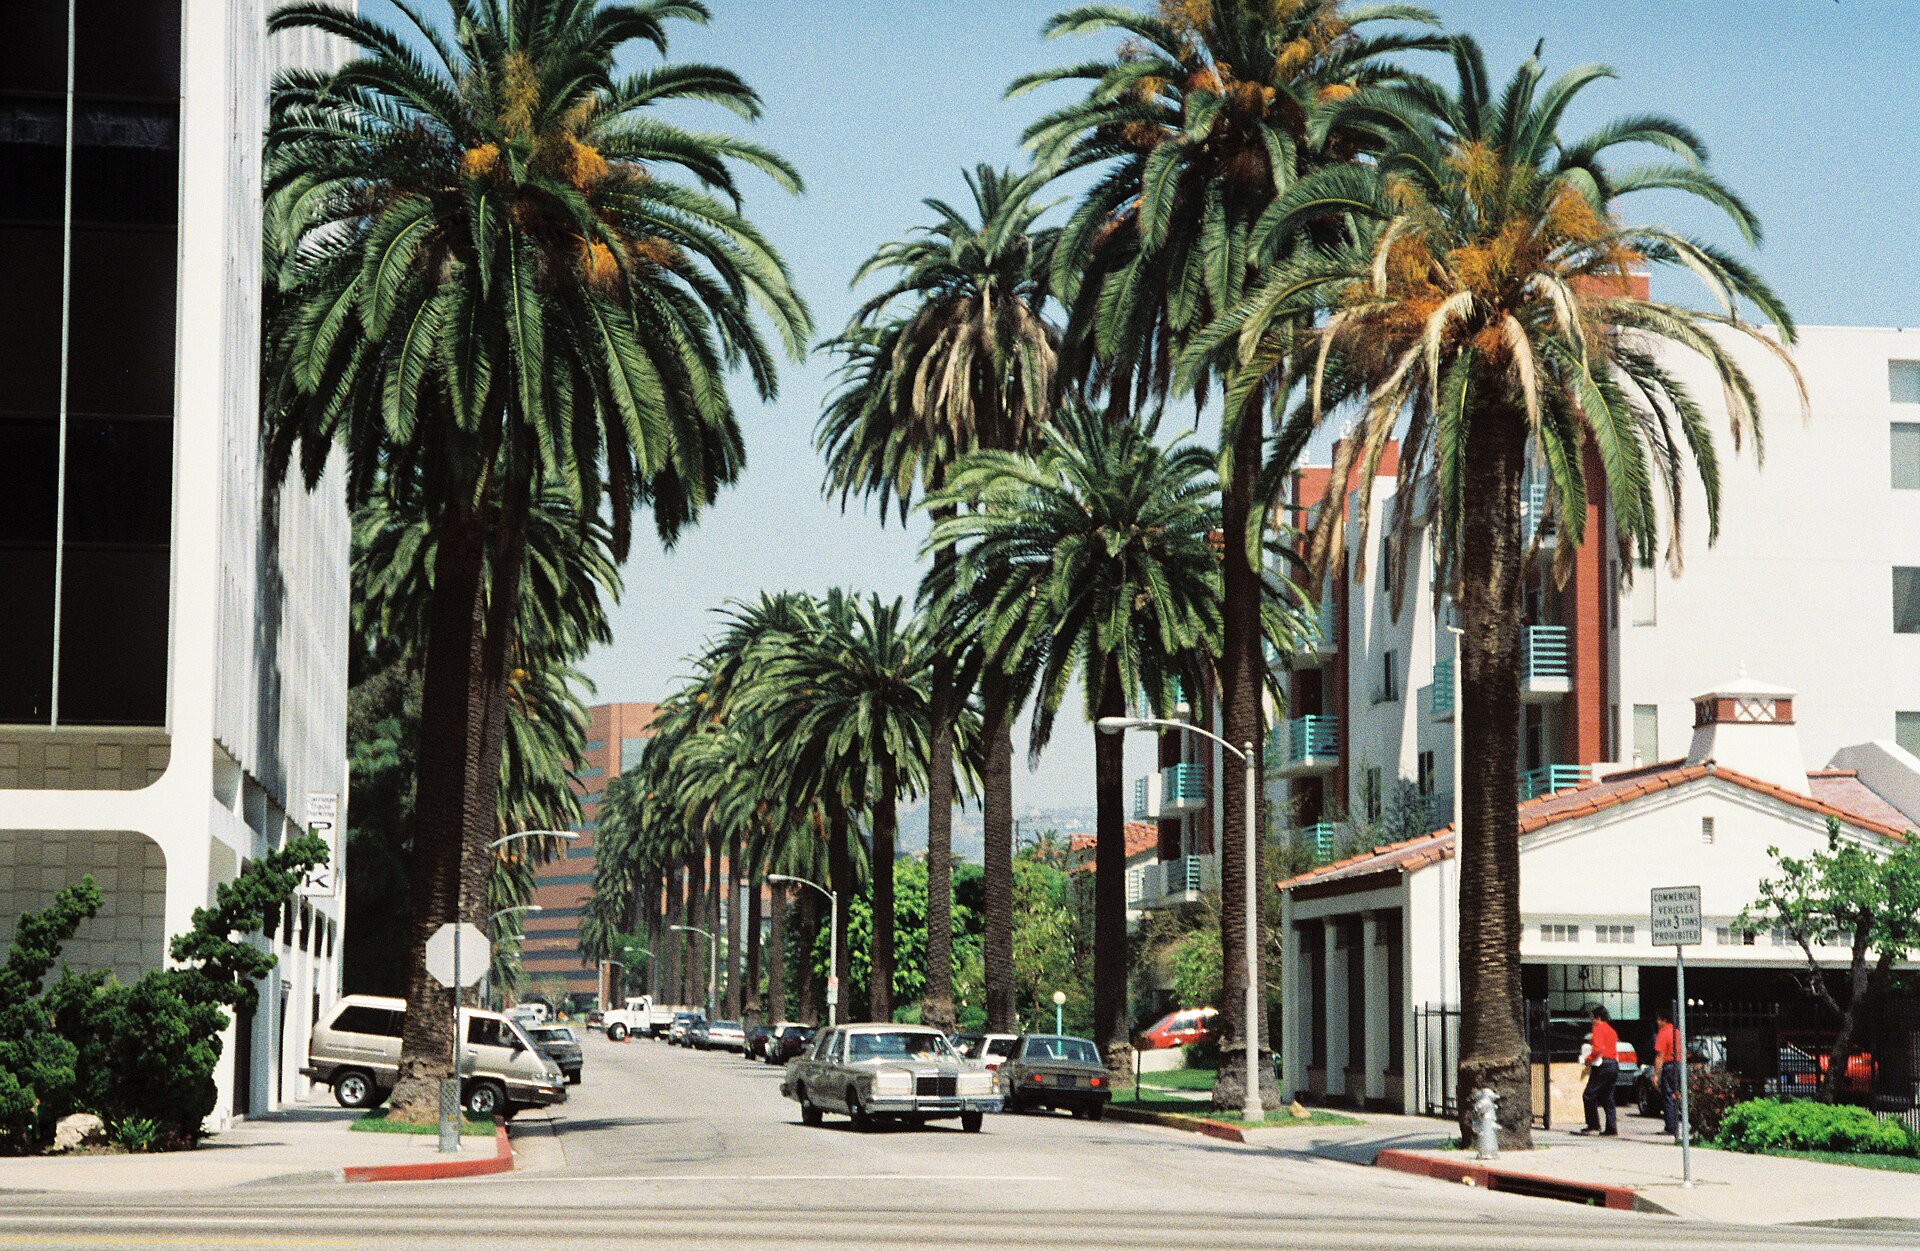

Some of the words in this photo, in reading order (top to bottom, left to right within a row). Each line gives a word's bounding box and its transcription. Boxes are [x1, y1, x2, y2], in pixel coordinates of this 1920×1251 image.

[1653, 892, 1698, 902] COMMERCIAL
[1658, 904, 1694, 915] VEHICLES
[1654, 918, 1672, 928] OVER
[1673, 915, 1679, 929] 3
[1681, 917, 1699, 926] TONS
[1654, 931, 1699, 941] PROHIBITED
